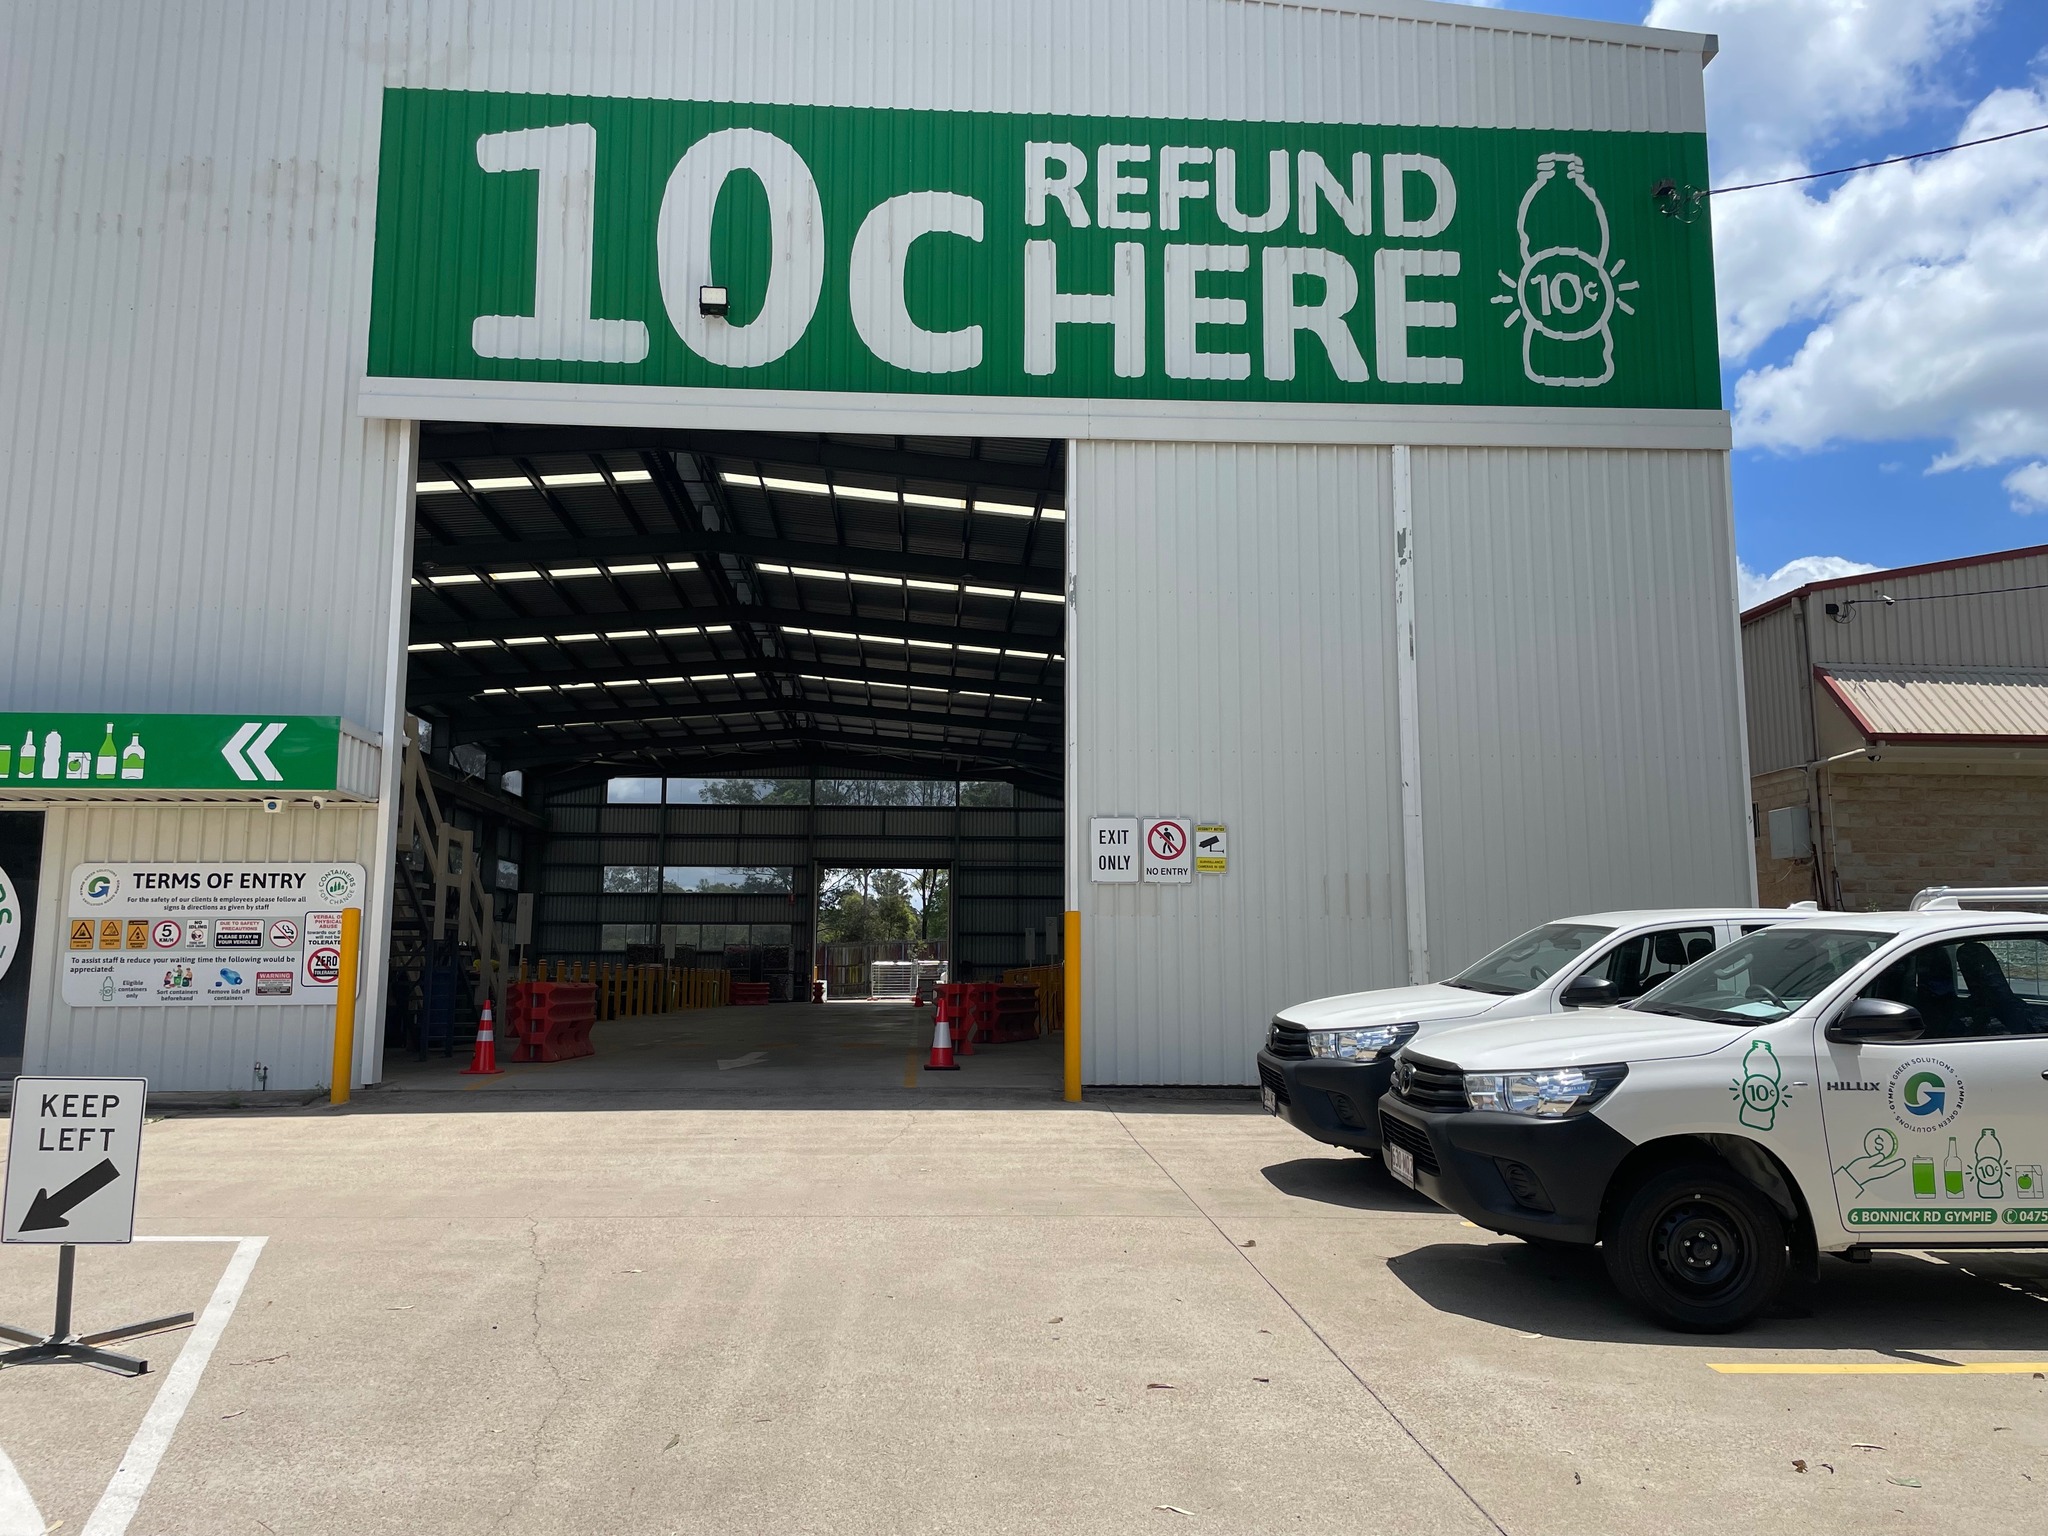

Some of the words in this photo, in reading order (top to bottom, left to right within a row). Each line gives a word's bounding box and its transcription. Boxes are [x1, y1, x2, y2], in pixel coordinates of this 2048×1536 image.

[1023, 140, 1457, 239] REFUND
[472, 123, 984, 374] 10c
[1023, 239, 1464, 384] HERE
[1099, 829, 1129, 844] EXIT
[1098, 855, 1131, 870] ONLY
[318, 869, 356, 887] CONTAINERS
[1146, 868, 1159, 876] NO
[1160, 868, 1189, 876] ENTRY
[133, 873, 200, 888] TERMS
[207, 873, 234, 888] OF
[240, 873, 307, 888] ENTRY
[329, 890, 354, 904] CHANGE
[161, 925, 172, 937] 5
[316, 956, 338, 966] ZERO
[1892, 1062, 1910, 1080] GREEN
[1911, 1057, 1954, 1074] SOLUTIONS
[1827, 1082, 1880, 1091] HILUX
[1956, 1080, 1965, 1109] GYMPIE
[40, 1094, 120, 1118] KEEP
[1895, 1116, 1937, 1133] SOLUTIONS
[1938, 1110, 1959, 1128] GREEN
[39, 1128, 115, 1151] LEFT
[1851, 1211, 1858, 1222] 6
[1862, 1211, 1920, 1222] BONNICK
[1923, 1211, 1941, 1222] RD
[1944, 1211, 1992, 1222] GYMPIE
[2019, 1211, 2048, 1222] 0475
